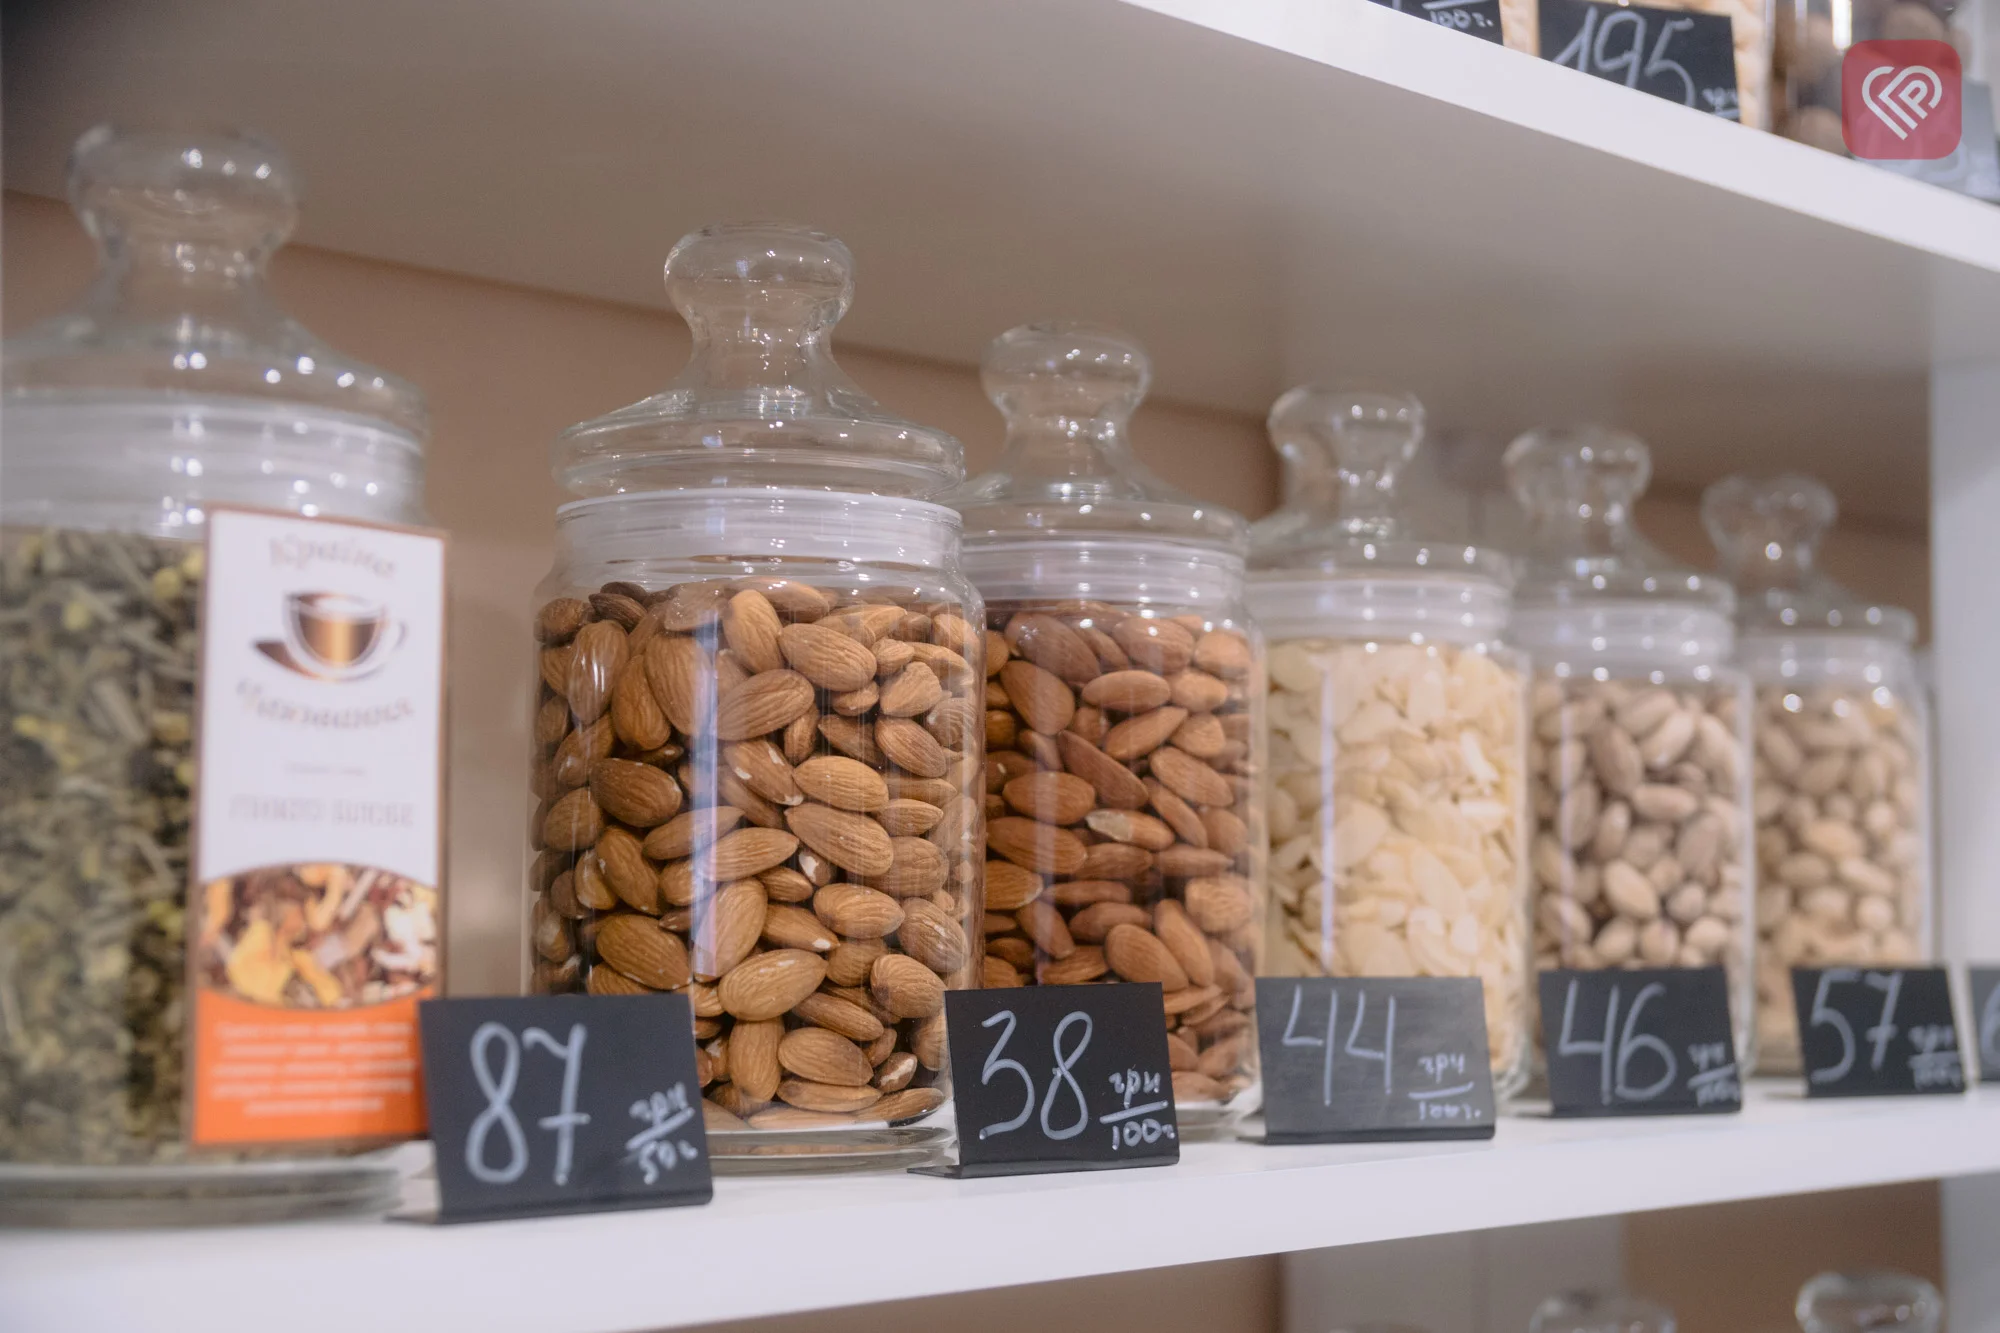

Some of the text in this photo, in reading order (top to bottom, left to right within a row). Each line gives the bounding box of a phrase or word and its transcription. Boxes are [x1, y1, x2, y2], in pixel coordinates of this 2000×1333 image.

[1552, 6, 1696, 108] 195
[979, 1010, 1093, 1140] 38
[1282, 984, 1397, 1106] 44
[1559, 978, 1677, 1106] 46
[1811, 968, 1903, 1085] 57
[465, 1021, 591, 1185] 87
